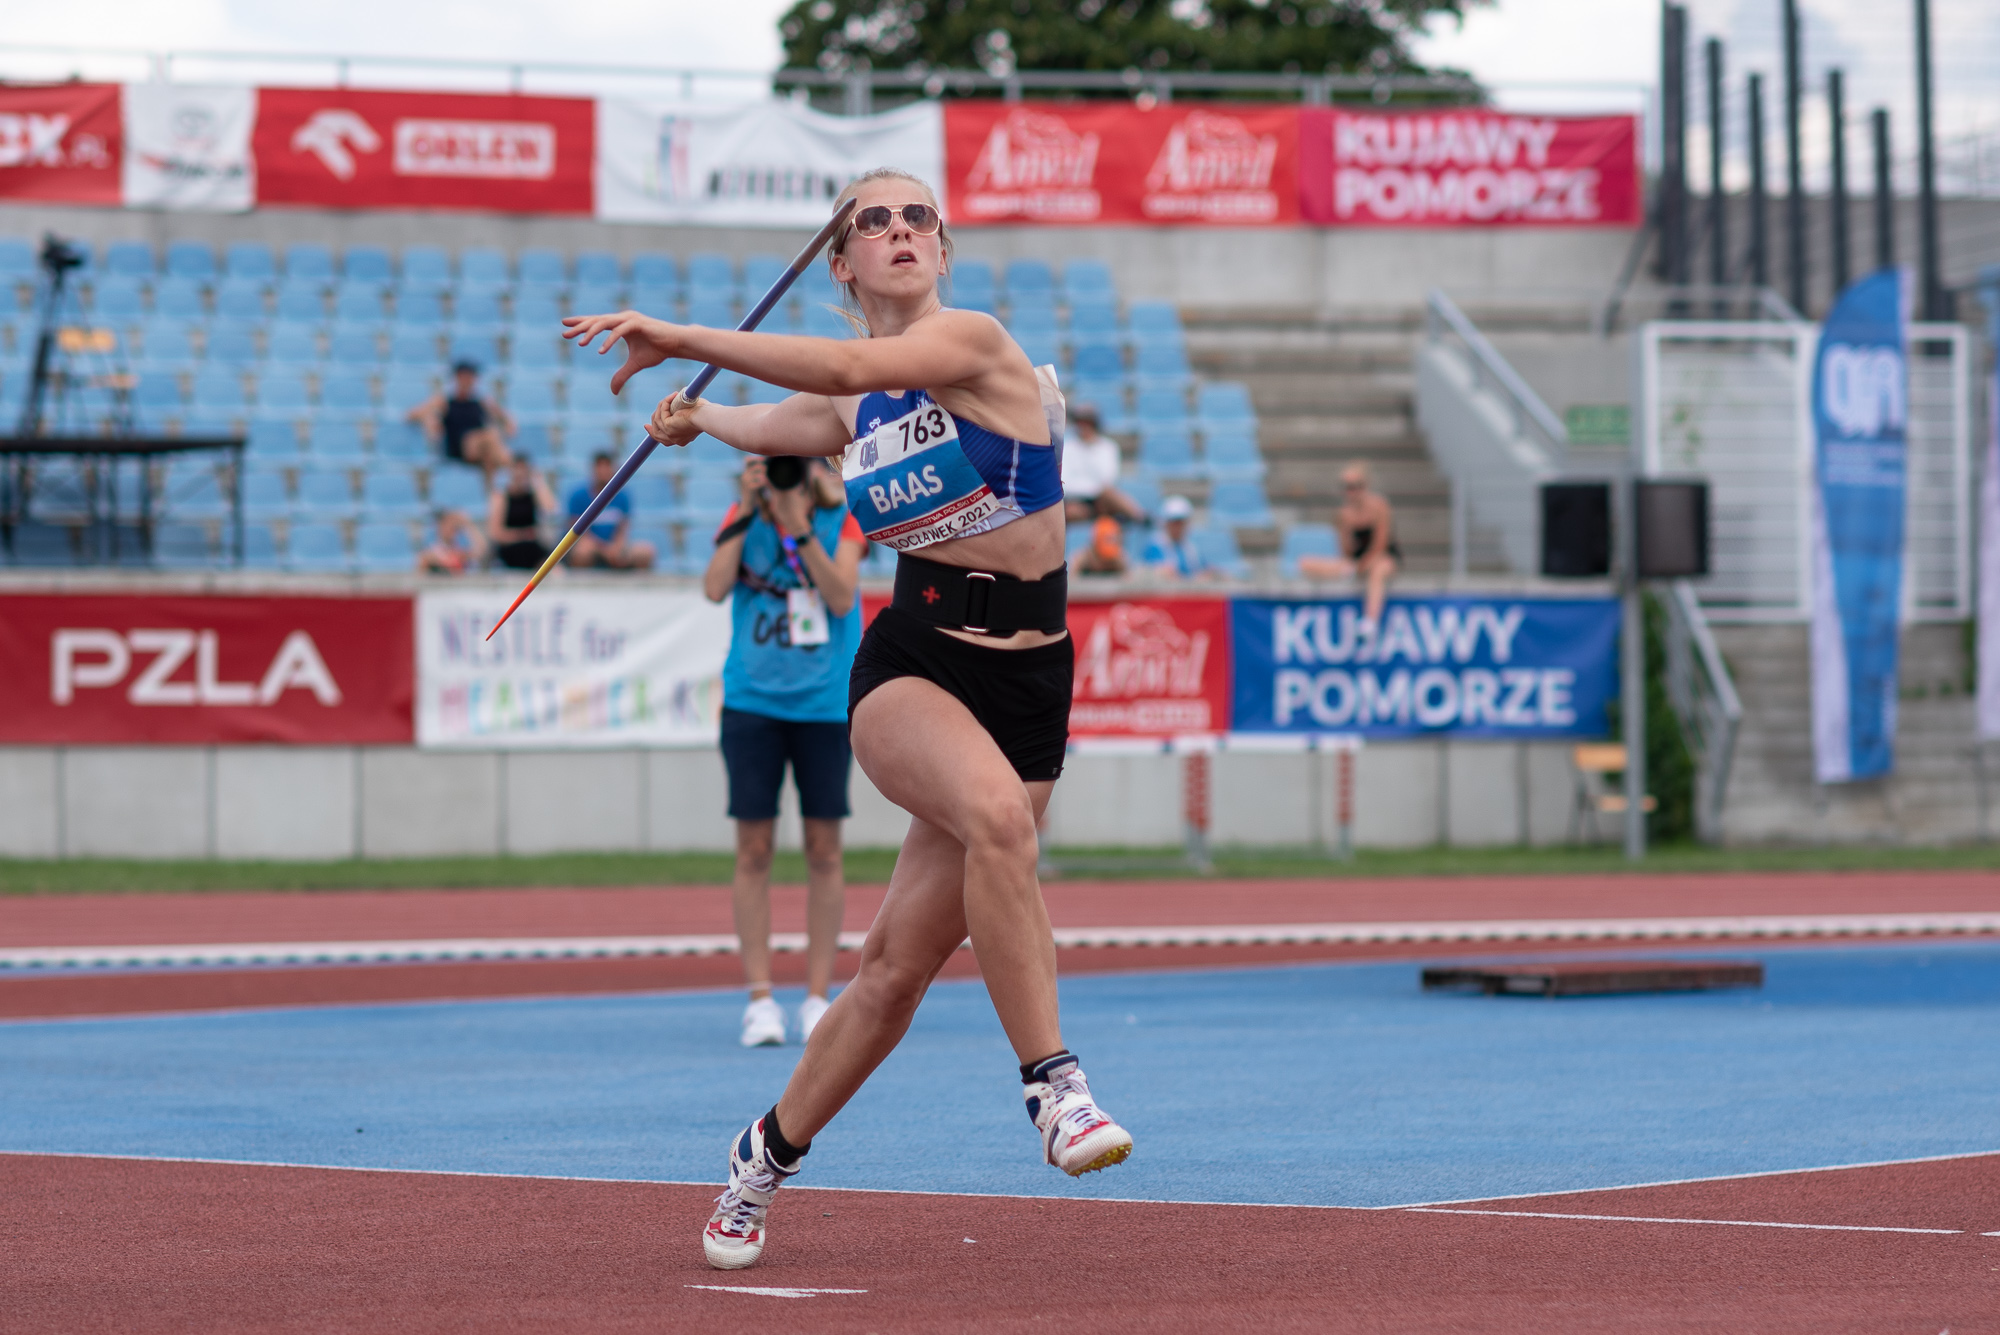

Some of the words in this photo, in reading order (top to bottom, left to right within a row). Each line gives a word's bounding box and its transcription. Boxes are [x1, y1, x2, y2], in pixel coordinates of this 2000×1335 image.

[1333, 114, 1559, 167] KUJAWY
[1333, 167, 1601, 219] POMORZE
[898, 408, 946, 453] 763
[868, 464, 943, 514] BAAS
[958, 501, 992, 528] 2021
[898, 512, 944, 533] MISTRZOSTWA
[943, 500, 970, 516] POLSKI
[1272, 604, 1524, 664] KUJAWY
[52, 628, 343, 706] PZLA
[1273, 667, 1576, 727] POMORZE
